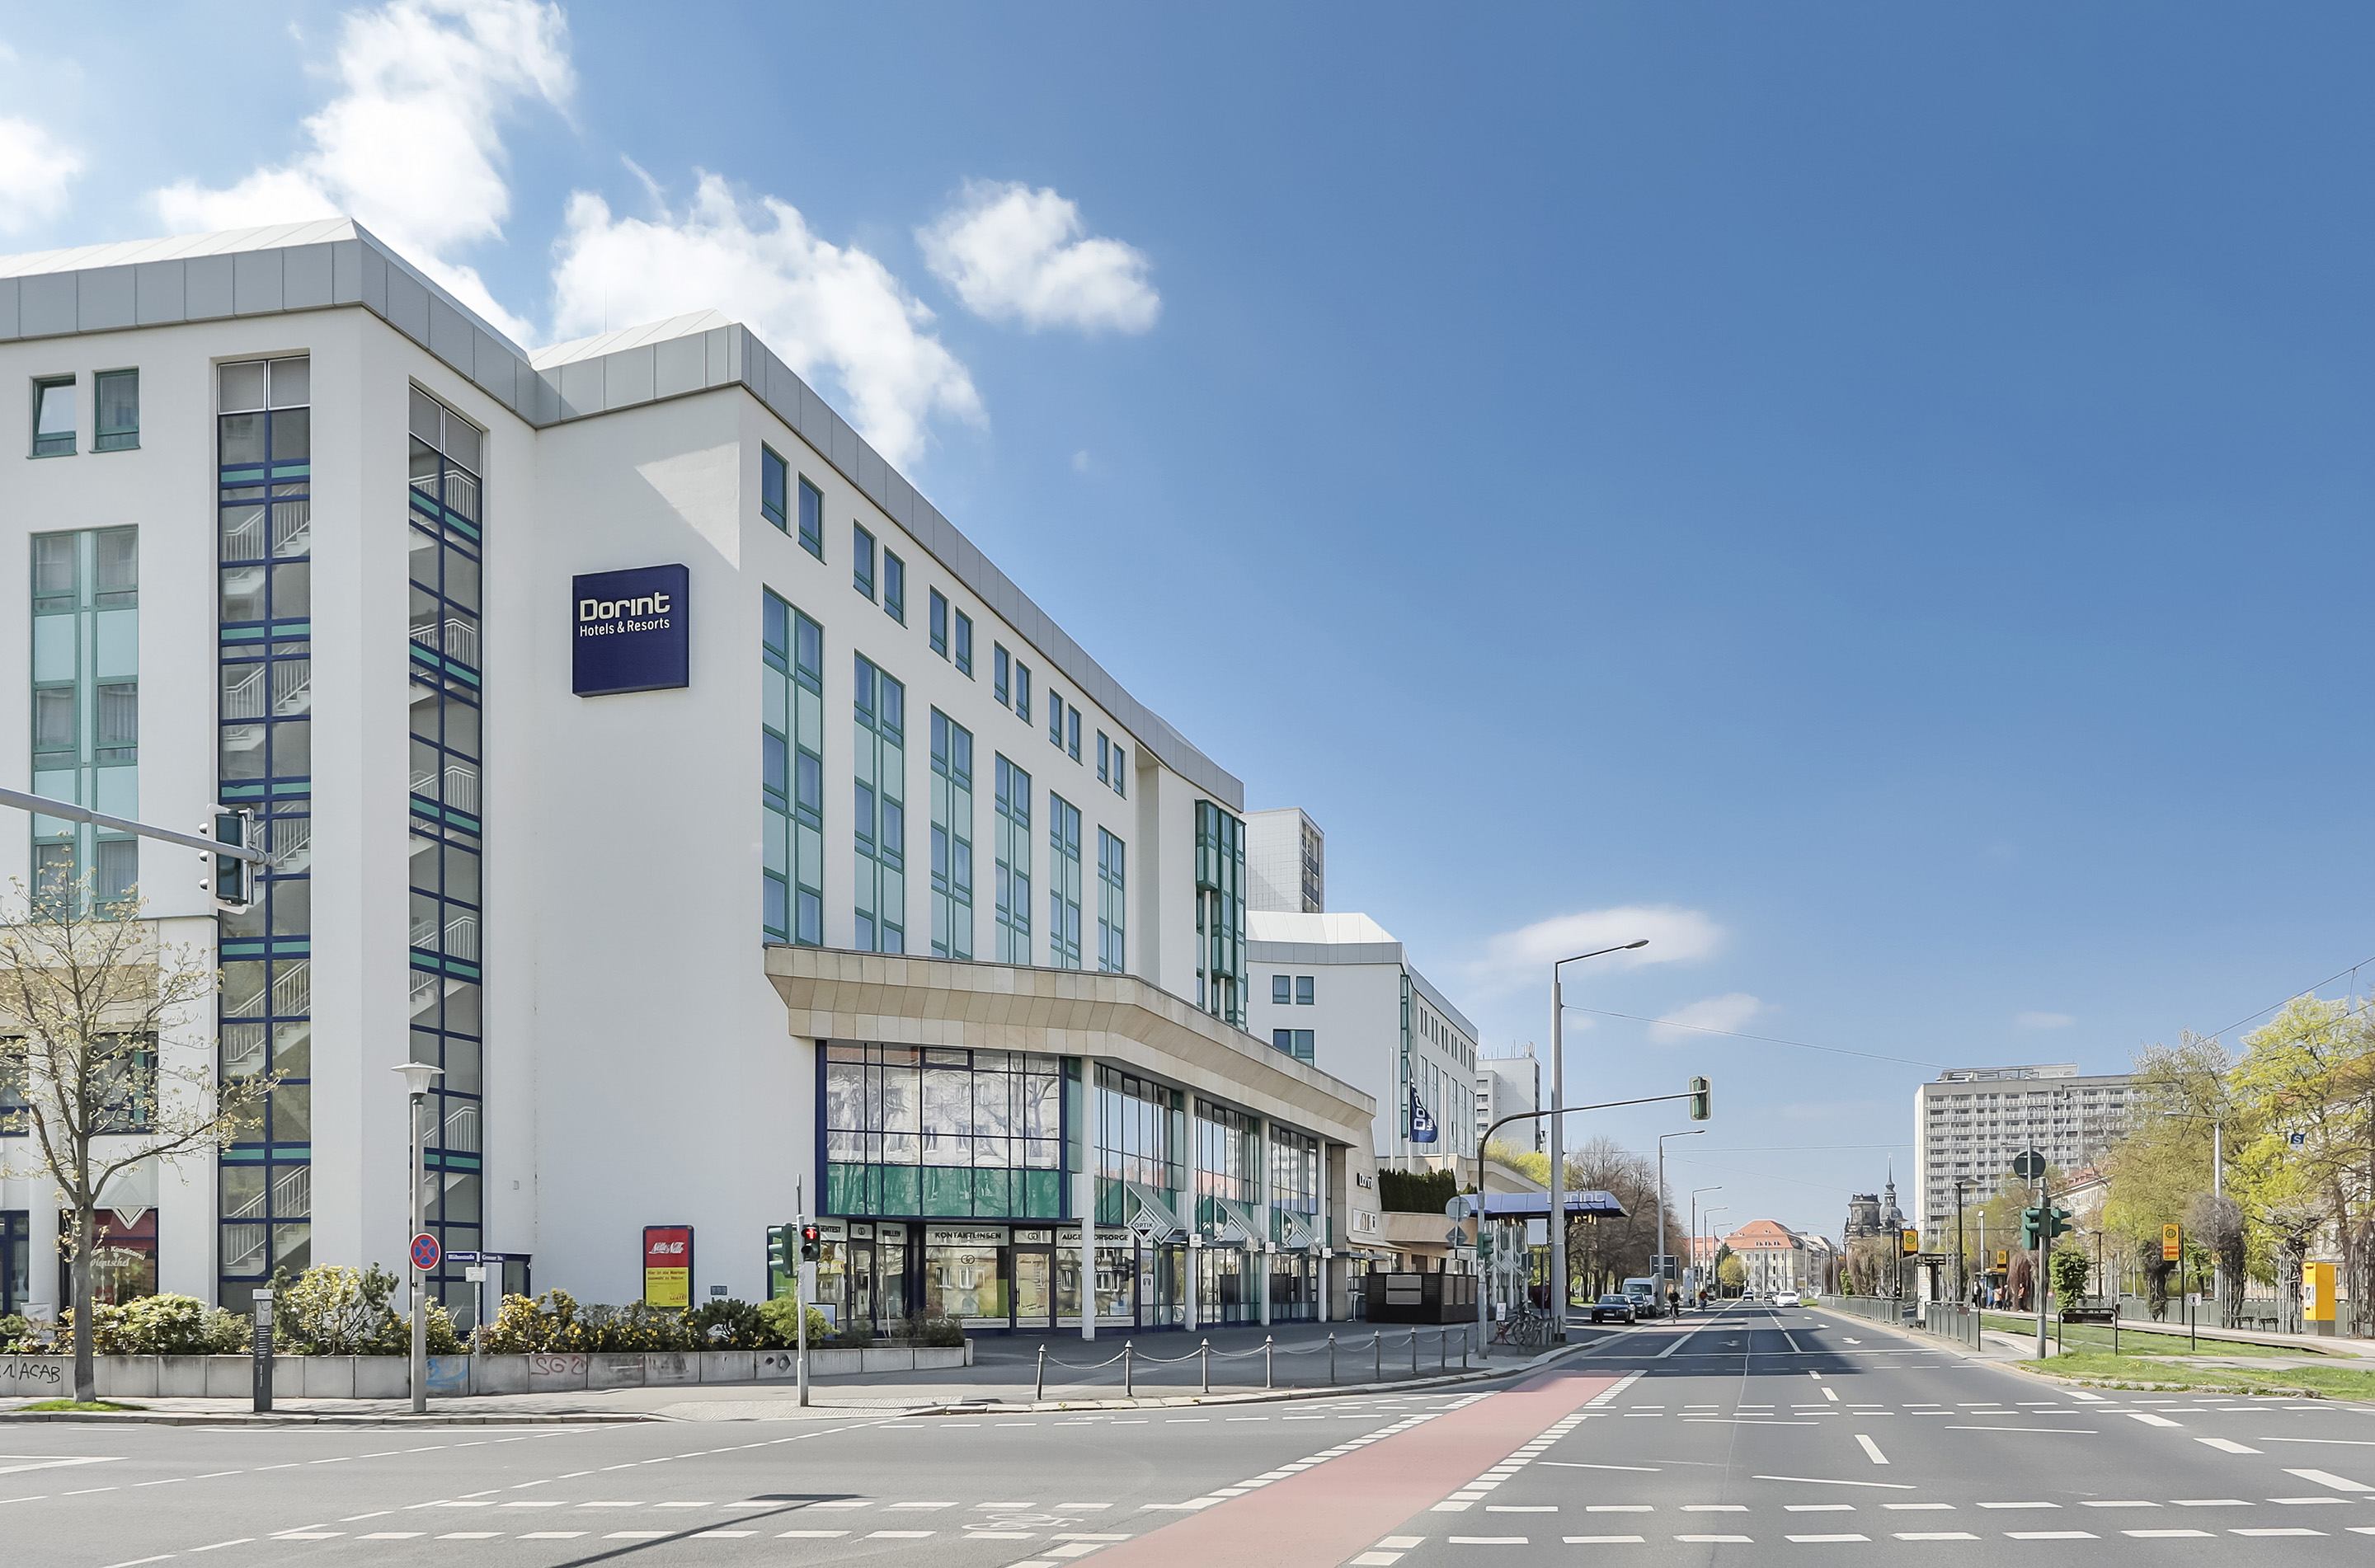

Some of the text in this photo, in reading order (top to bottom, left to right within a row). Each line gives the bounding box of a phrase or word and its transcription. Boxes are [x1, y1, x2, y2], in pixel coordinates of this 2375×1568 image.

[580, 591, 670, 622] Dorint
[580, 617, 670, 637] Hotels & Resorts
[2293, 1134, 2302, 1143] S
[934, 1232, 1002, 1240] KONTAKTLINSEN
[1061, 1233, 1129, 1242] AUGEORSORGE
[110, 1245, 146, 1261] Konditorei
[19, 1362, 61, 1383] ACAB
